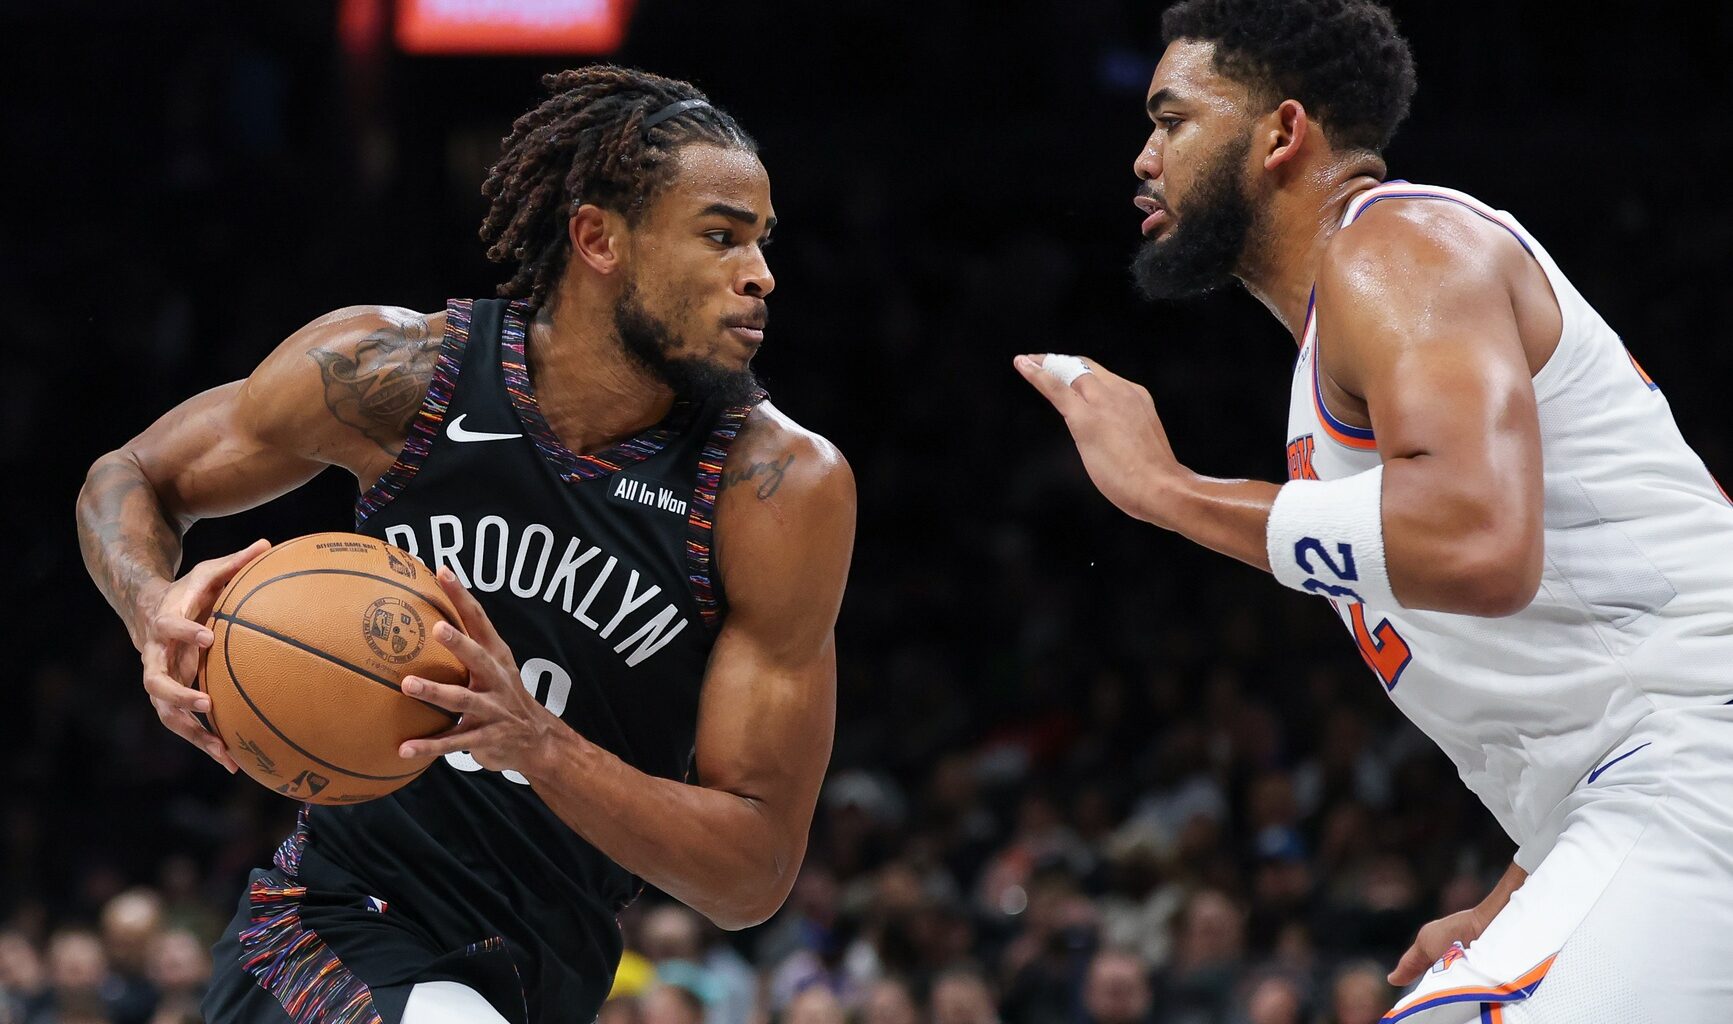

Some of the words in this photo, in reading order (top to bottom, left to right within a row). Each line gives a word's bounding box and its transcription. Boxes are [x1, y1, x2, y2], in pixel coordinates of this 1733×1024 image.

[614, 477, 639, 501] All
[638, 483, 655, 506] In
[657, 487, 687, 515] Won
